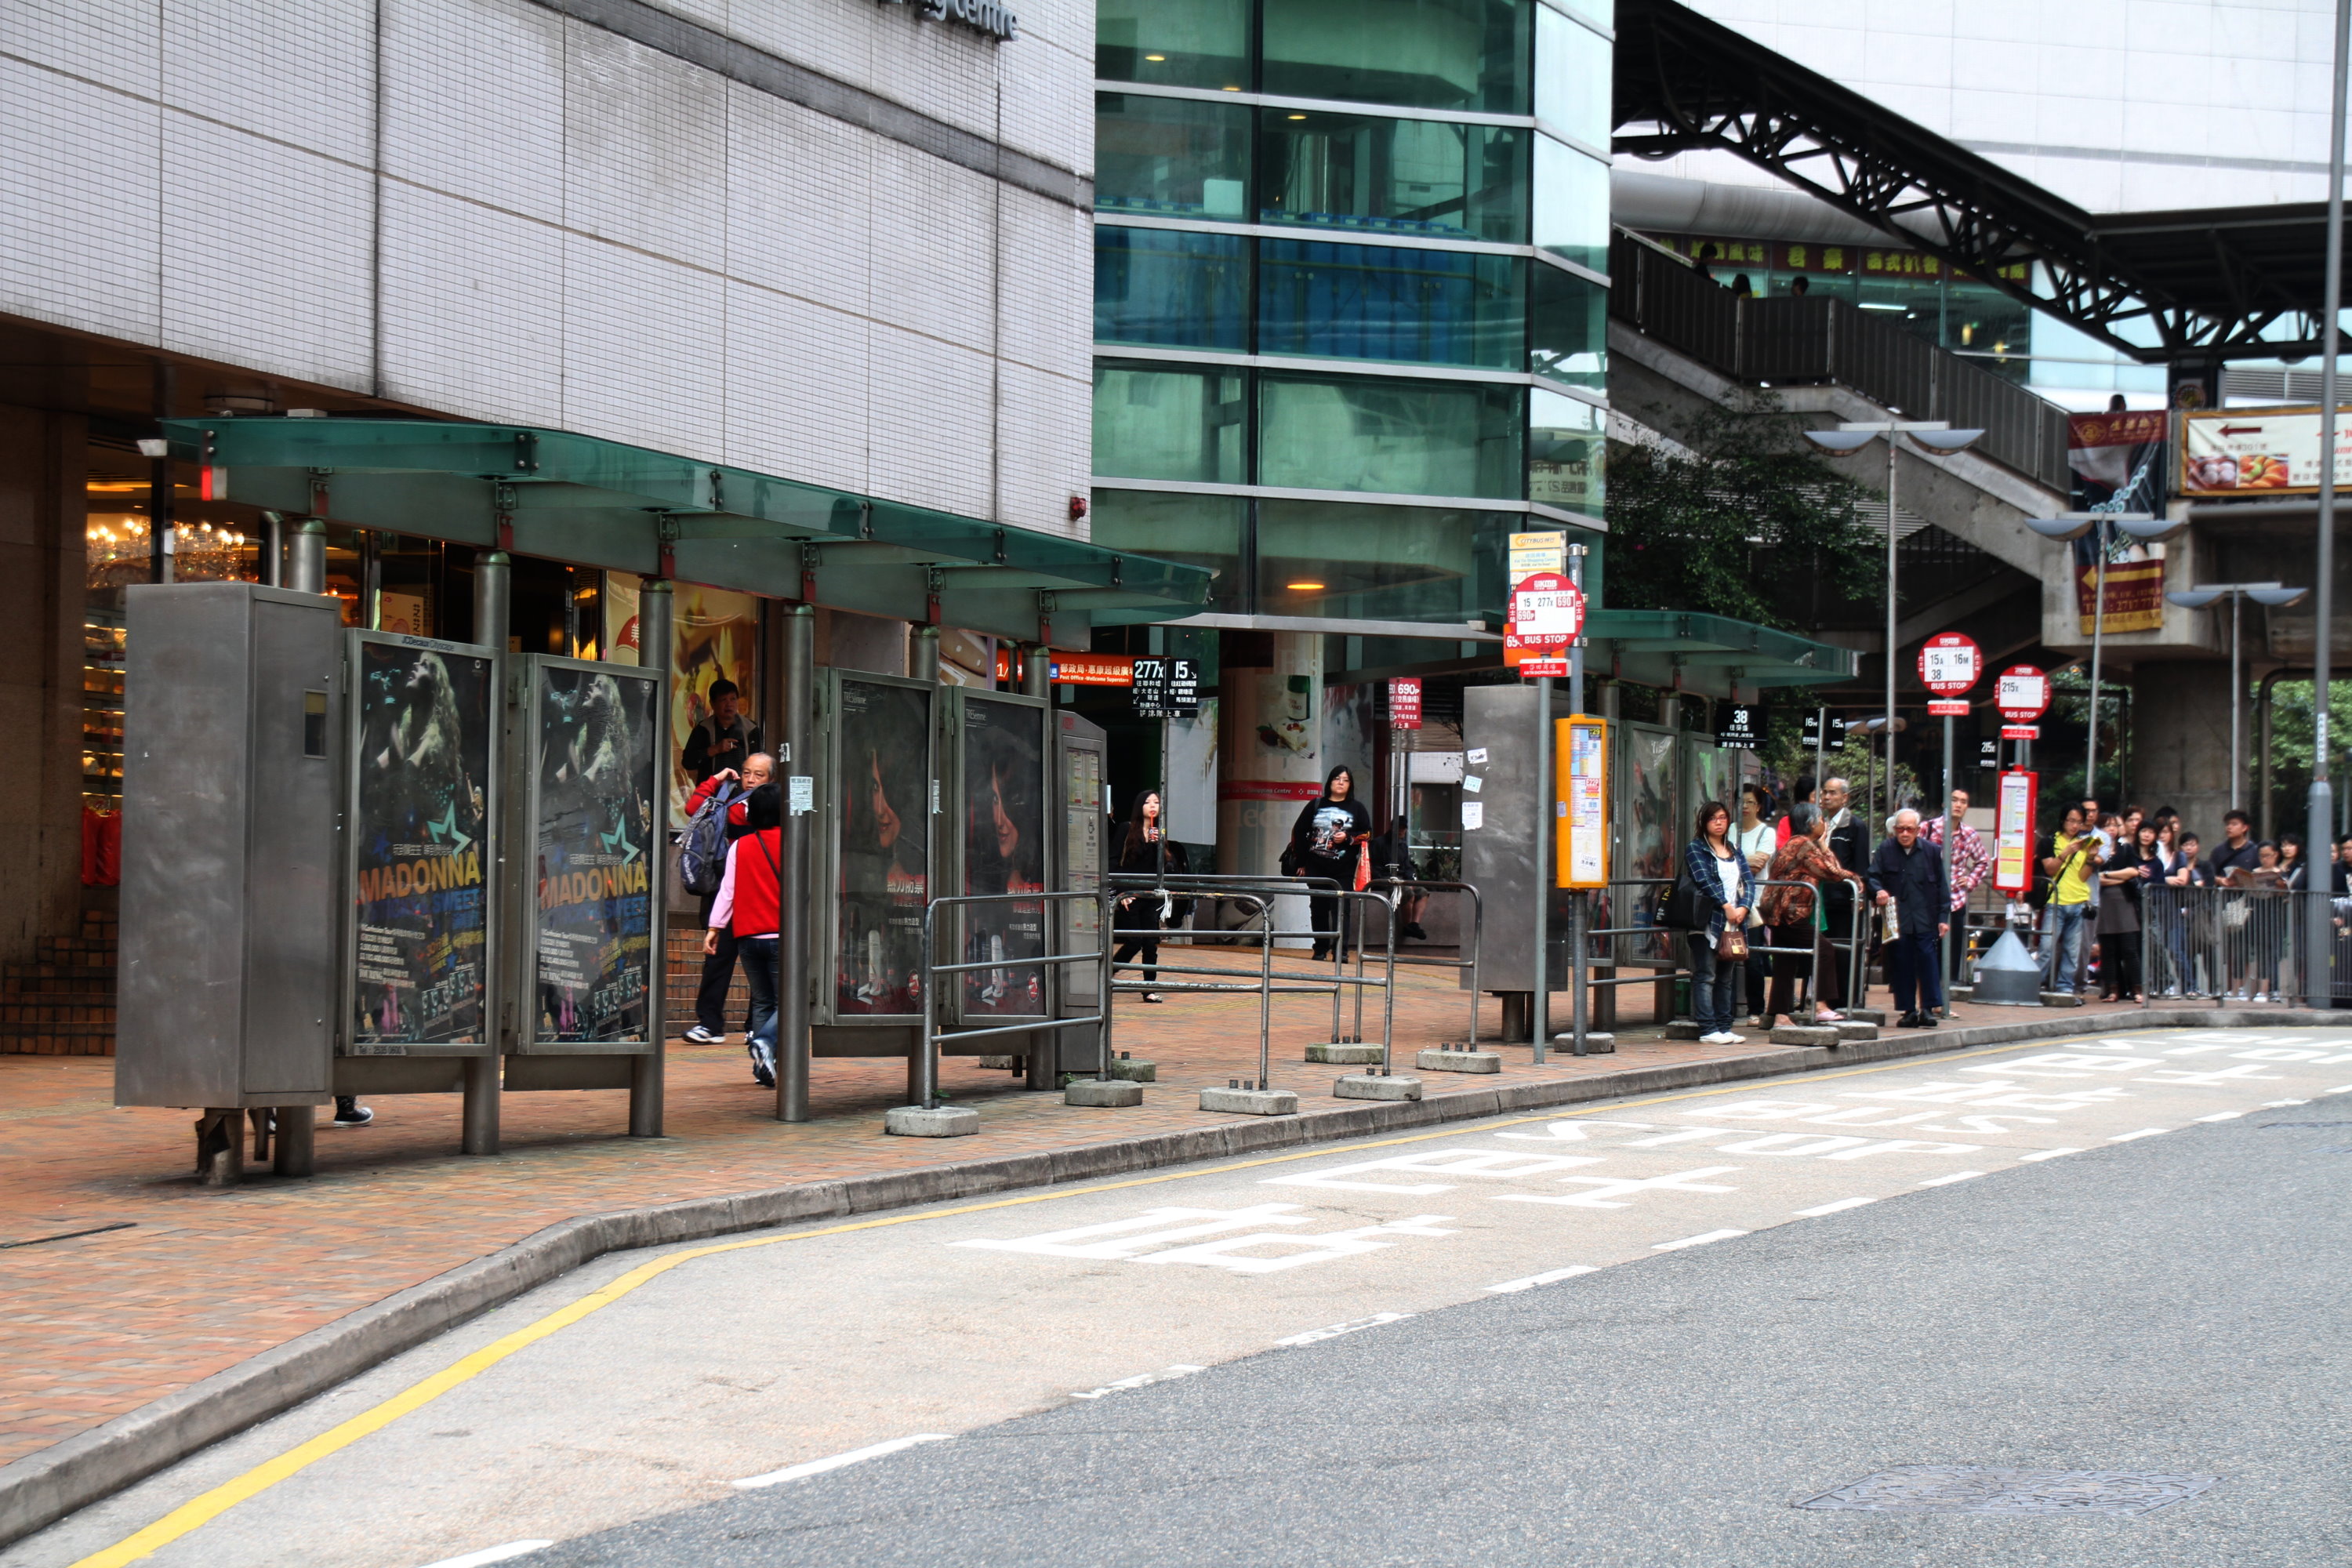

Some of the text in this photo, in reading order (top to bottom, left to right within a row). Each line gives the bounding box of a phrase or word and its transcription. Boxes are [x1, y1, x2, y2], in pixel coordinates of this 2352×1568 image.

[1524, 597, 1531, 608] 15
[1557, 597, 1571, 607] 690
[401, 637, 430, 648] JCDecaux
[1524, 635, 1566, 644] BUS STOP
[1930, 654, 1944, 665] 15A
[1954, 653, 1969, 664] 16M
[1176, 661, 1189, 679] 15
[1931, 669, 1941, 680] 38
[1733, 710, 1748, 724] 38
[1806, 717, 1818, 727] 16M
[1832, 719, 1844, 728] 15A
[359, 851, 481, 904] MADONNA
[540, 861, 648, 910] MADONNA
[1681, 1100, 2058, 1134] BUS
[1494, 1116, 1986, 1161] STOP
